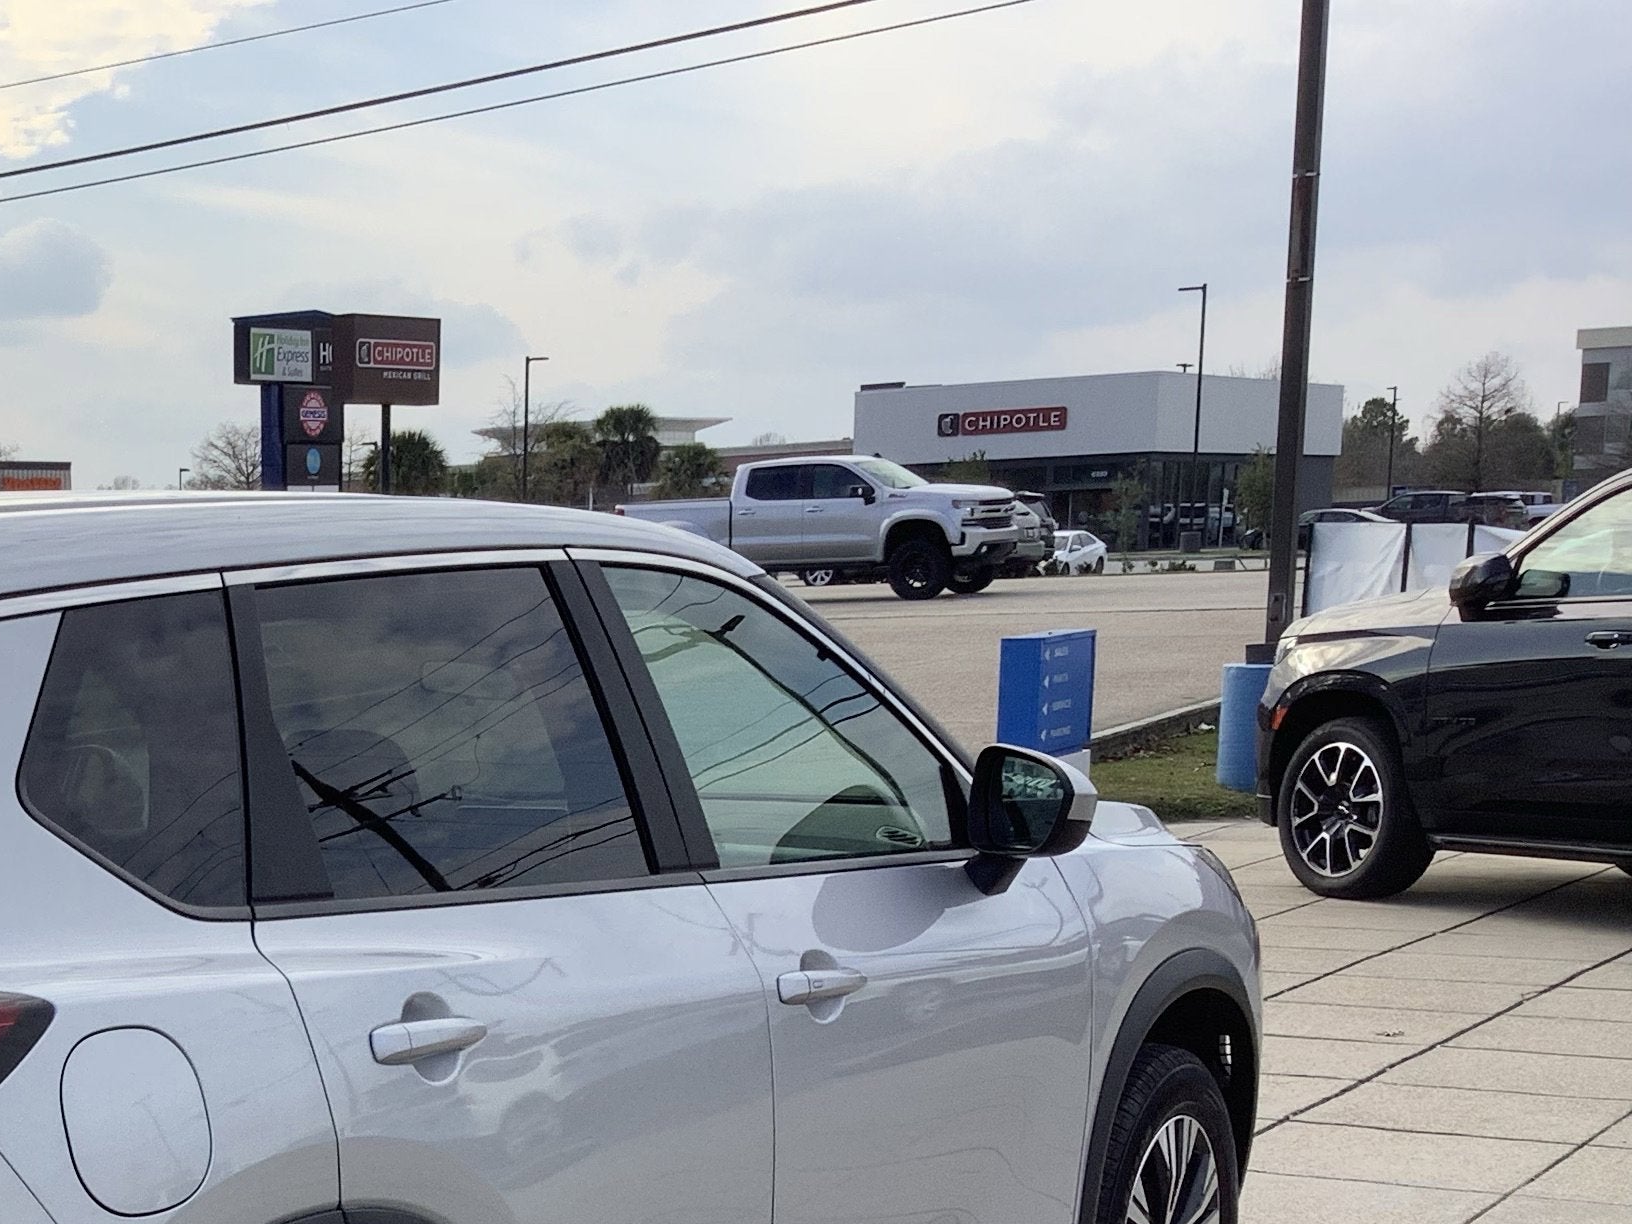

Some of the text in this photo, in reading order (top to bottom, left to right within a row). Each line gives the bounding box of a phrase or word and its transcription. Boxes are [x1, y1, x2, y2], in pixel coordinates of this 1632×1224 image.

[277, 346, 309, 365] Express
[375, 346, 432, 363] CHIPOTLE
[383, 371, 431, 380] MEXICAN GRILL
[964, 411, 1061, 431] CHIPOTLE
